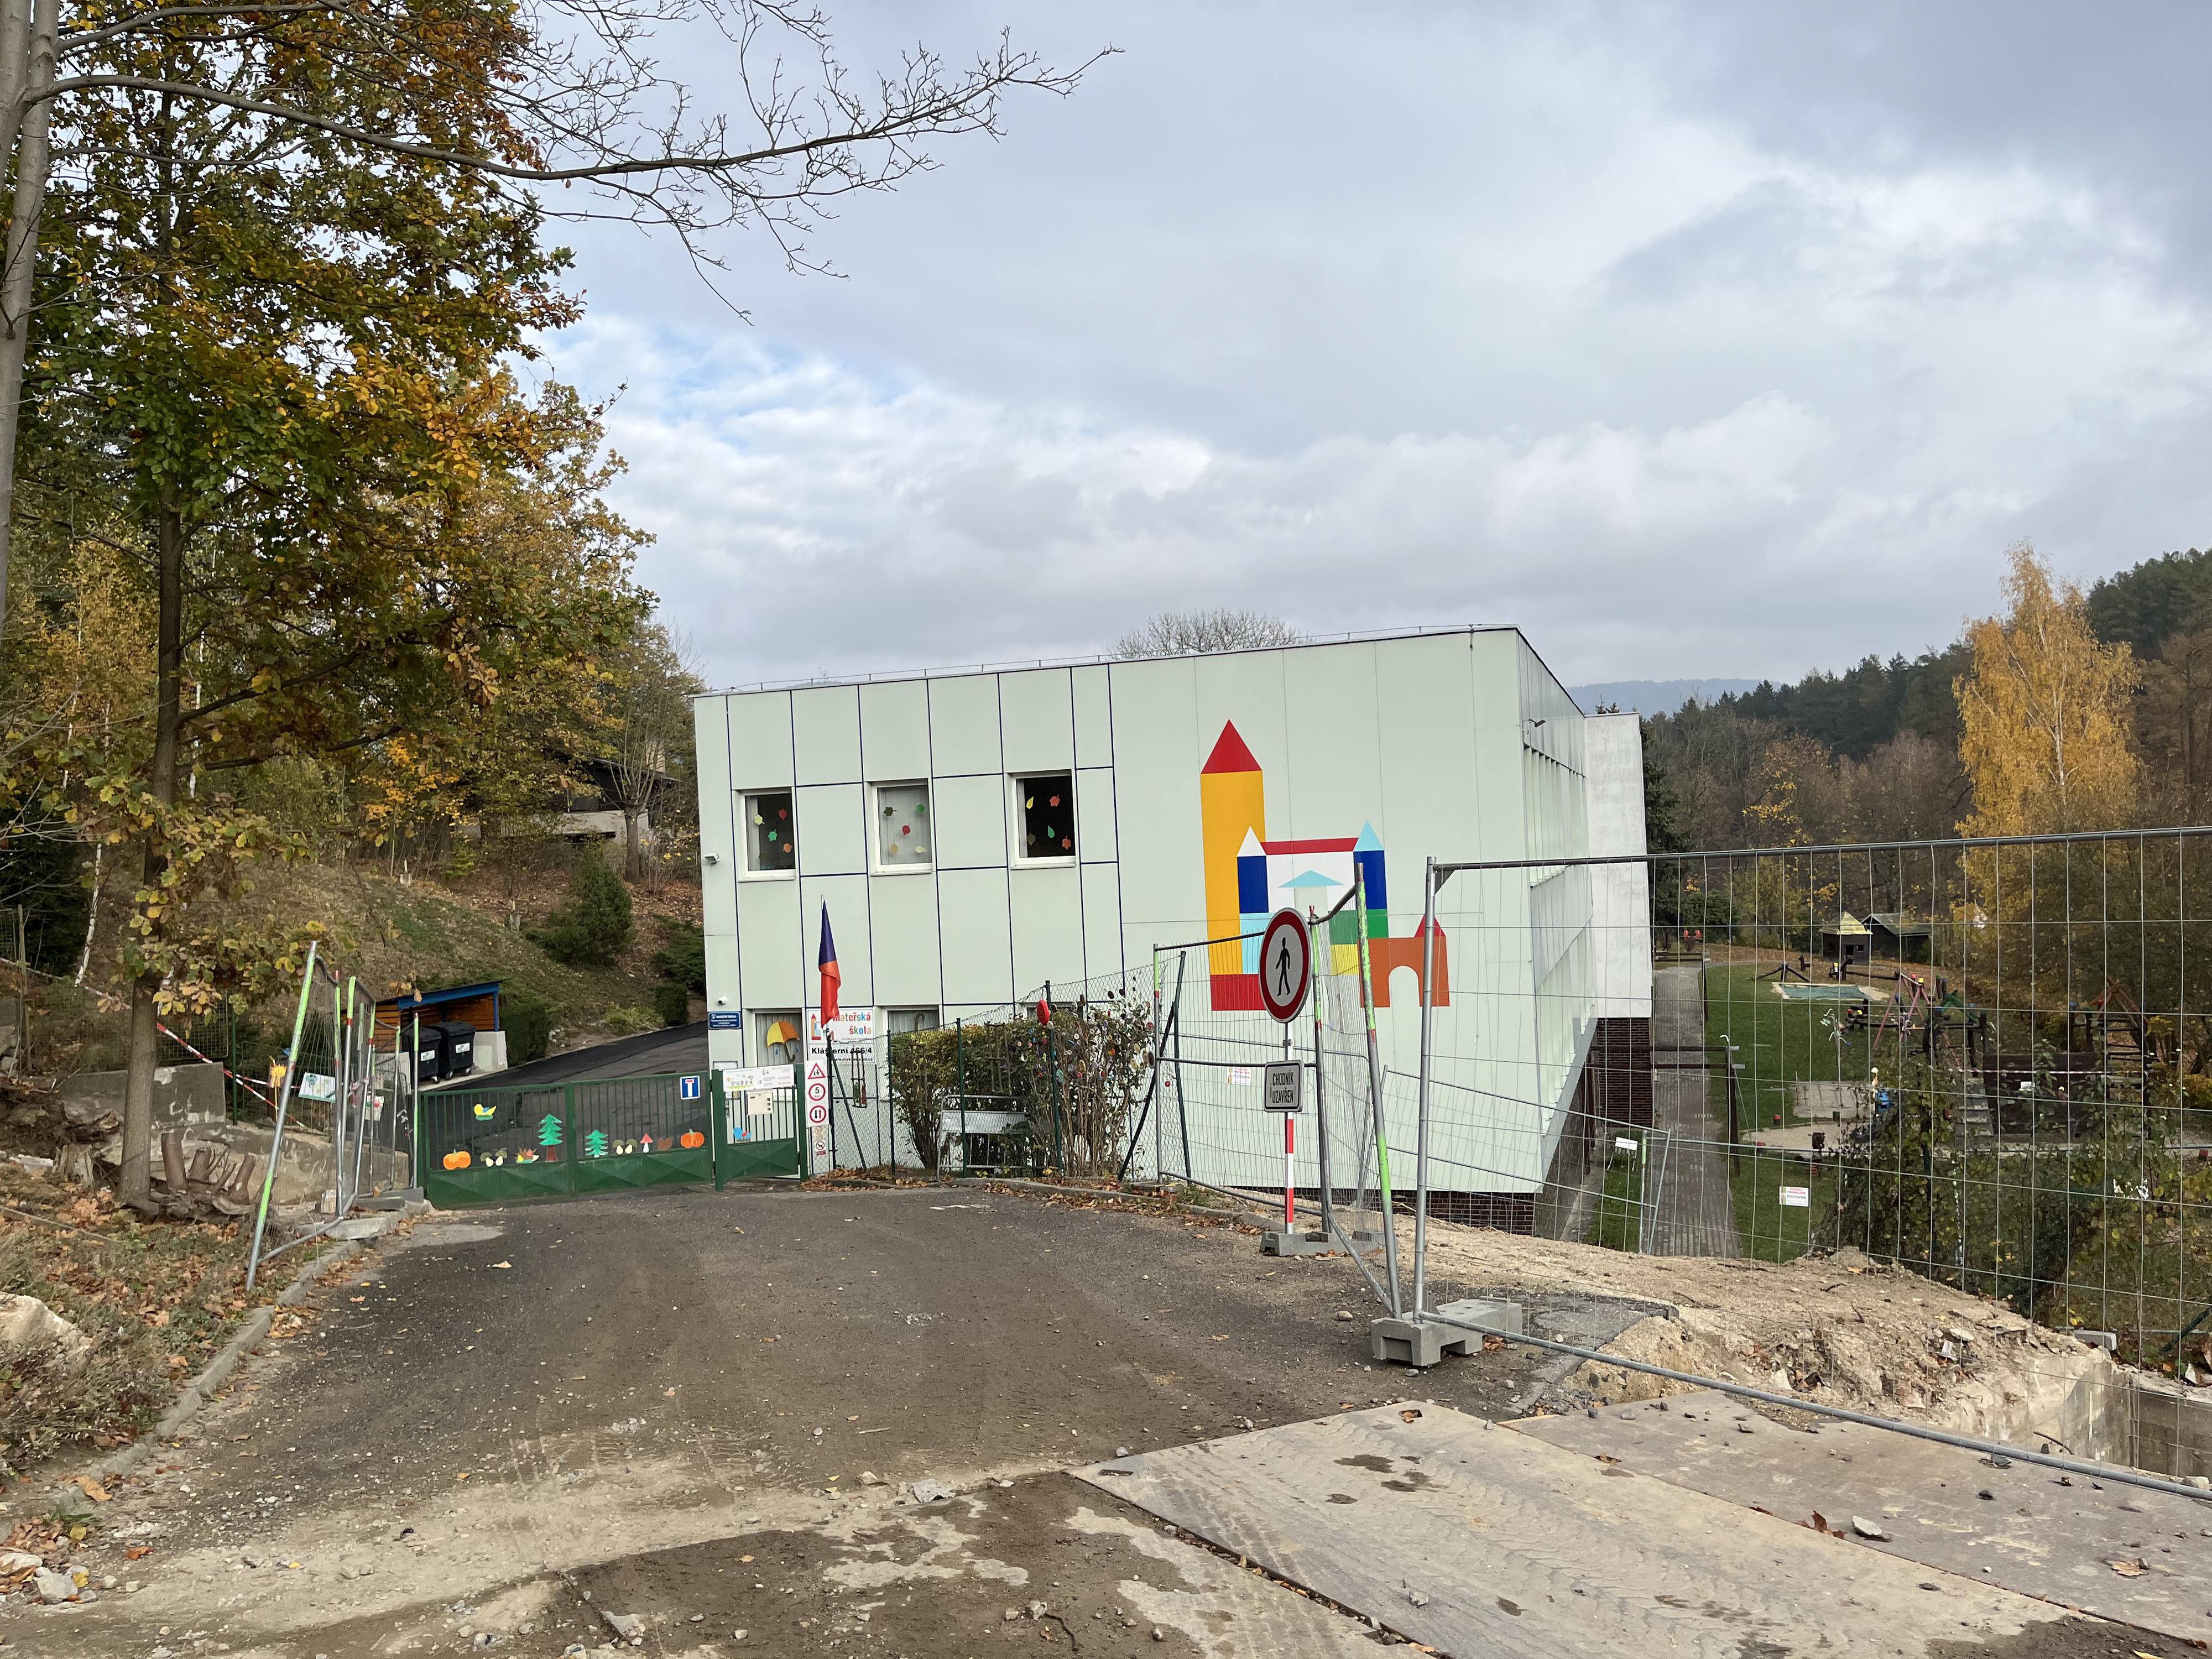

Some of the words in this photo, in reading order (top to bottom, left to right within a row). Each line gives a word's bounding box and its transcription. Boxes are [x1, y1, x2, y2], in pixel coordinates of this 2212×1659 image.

[849, 1026, 871, 1035] škola
[1272, 1070, 1294, 1086] CHODNÍK
[1272, 1087, 1294, 1103] UZAVŘEN
